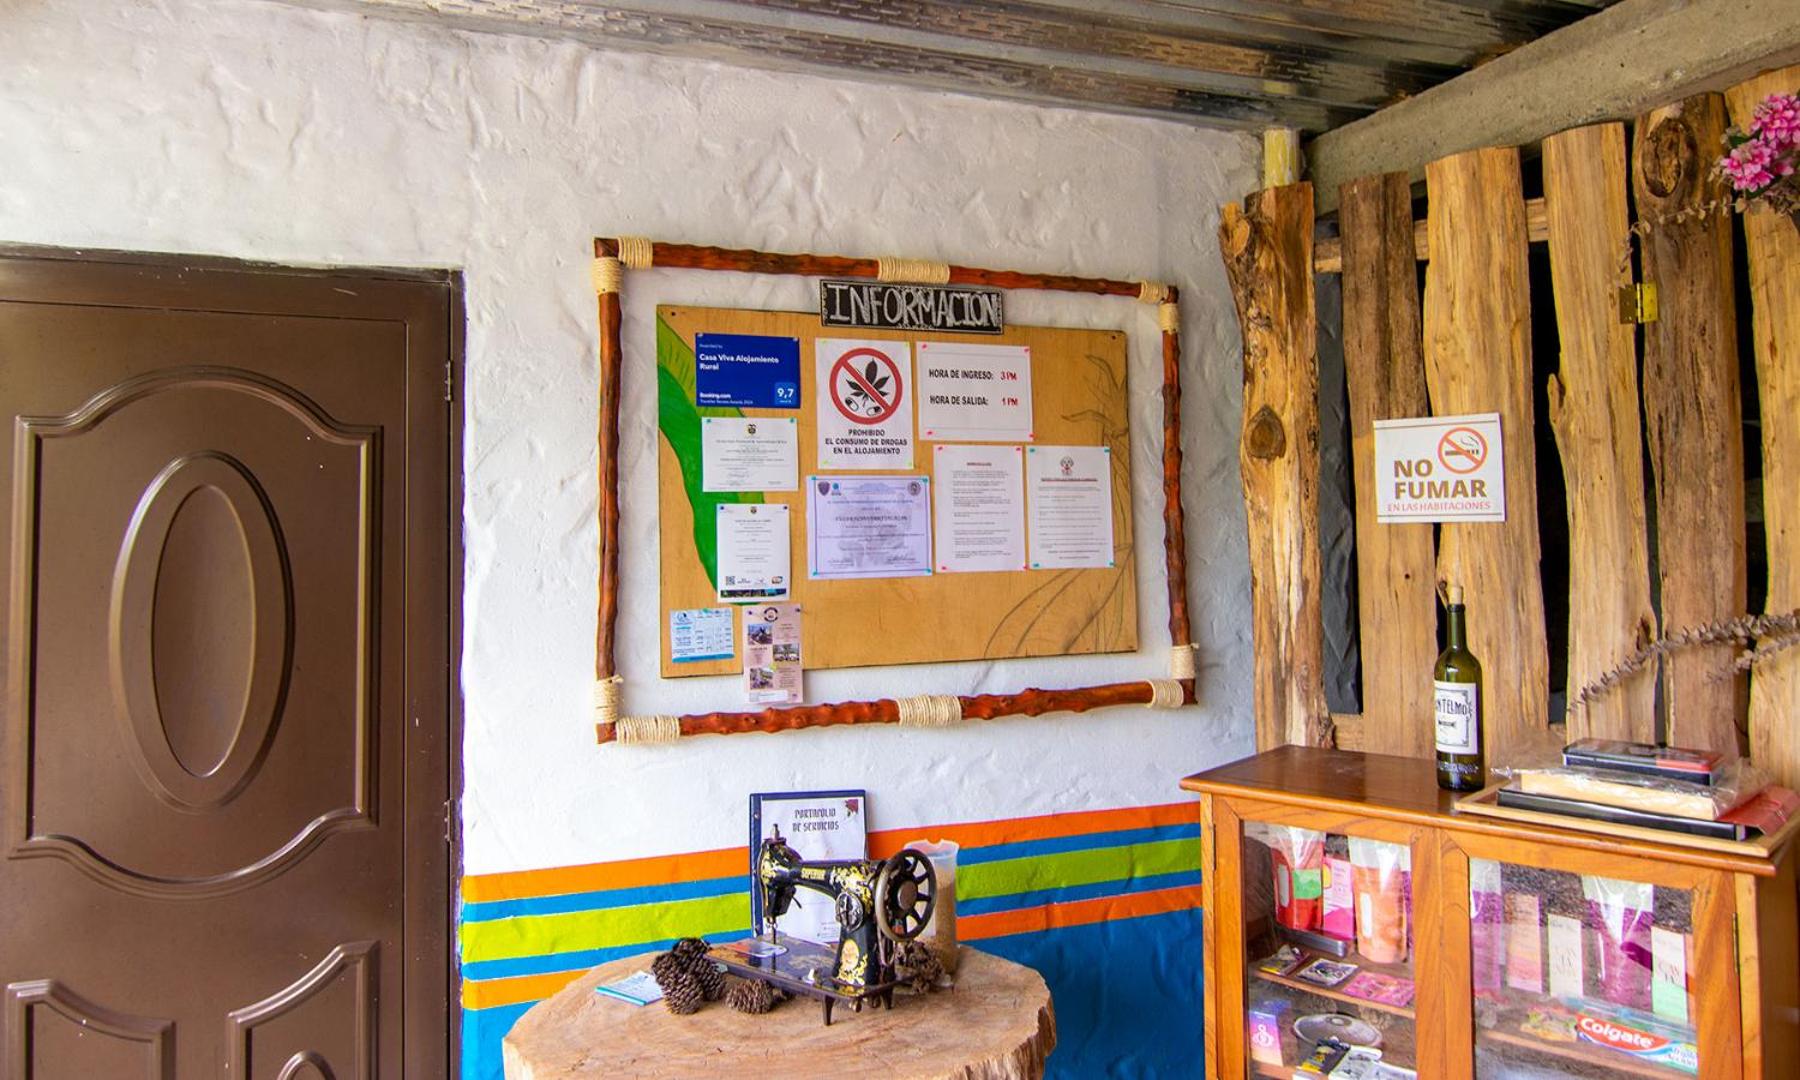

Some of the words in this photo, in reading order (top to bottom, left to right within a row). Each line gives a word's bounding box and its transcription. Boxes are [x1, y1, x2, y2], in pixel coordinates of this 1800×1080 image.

[700, 353, 717, 361] Casa
[736, 354, 779, 363] Alojamiento
[929, 368, 949, 378] HORA
[950, 369, 959, 378] DE
[961, 370, 993, 380] INGRESO:
[1000, 371, 1005, 380] 3
[1006, 372, 1017, 380] PM
[699, 392, 731, 400] Booking.com
[777, 388, 794, 398] 9,7
[930, 395, 950, 404] HORA
[951, 395, 960, 405] DE
[962, 396, 988, 405] SALIDA:
[1007, 397, 1018, 406] PM
[854, 447, 901, 455] ALOJAMIENTO
[1393, 459, 1433, 478] NO
[1394, 479, 1488, 500] FUMAR
[1387, 503, 1400, 511] EN
[1402, 502, 1419, 511] LAS
[1420, 501, 1491, 511] HABITACIONES
[1581, 1018, 1654, 1048] Colgate
